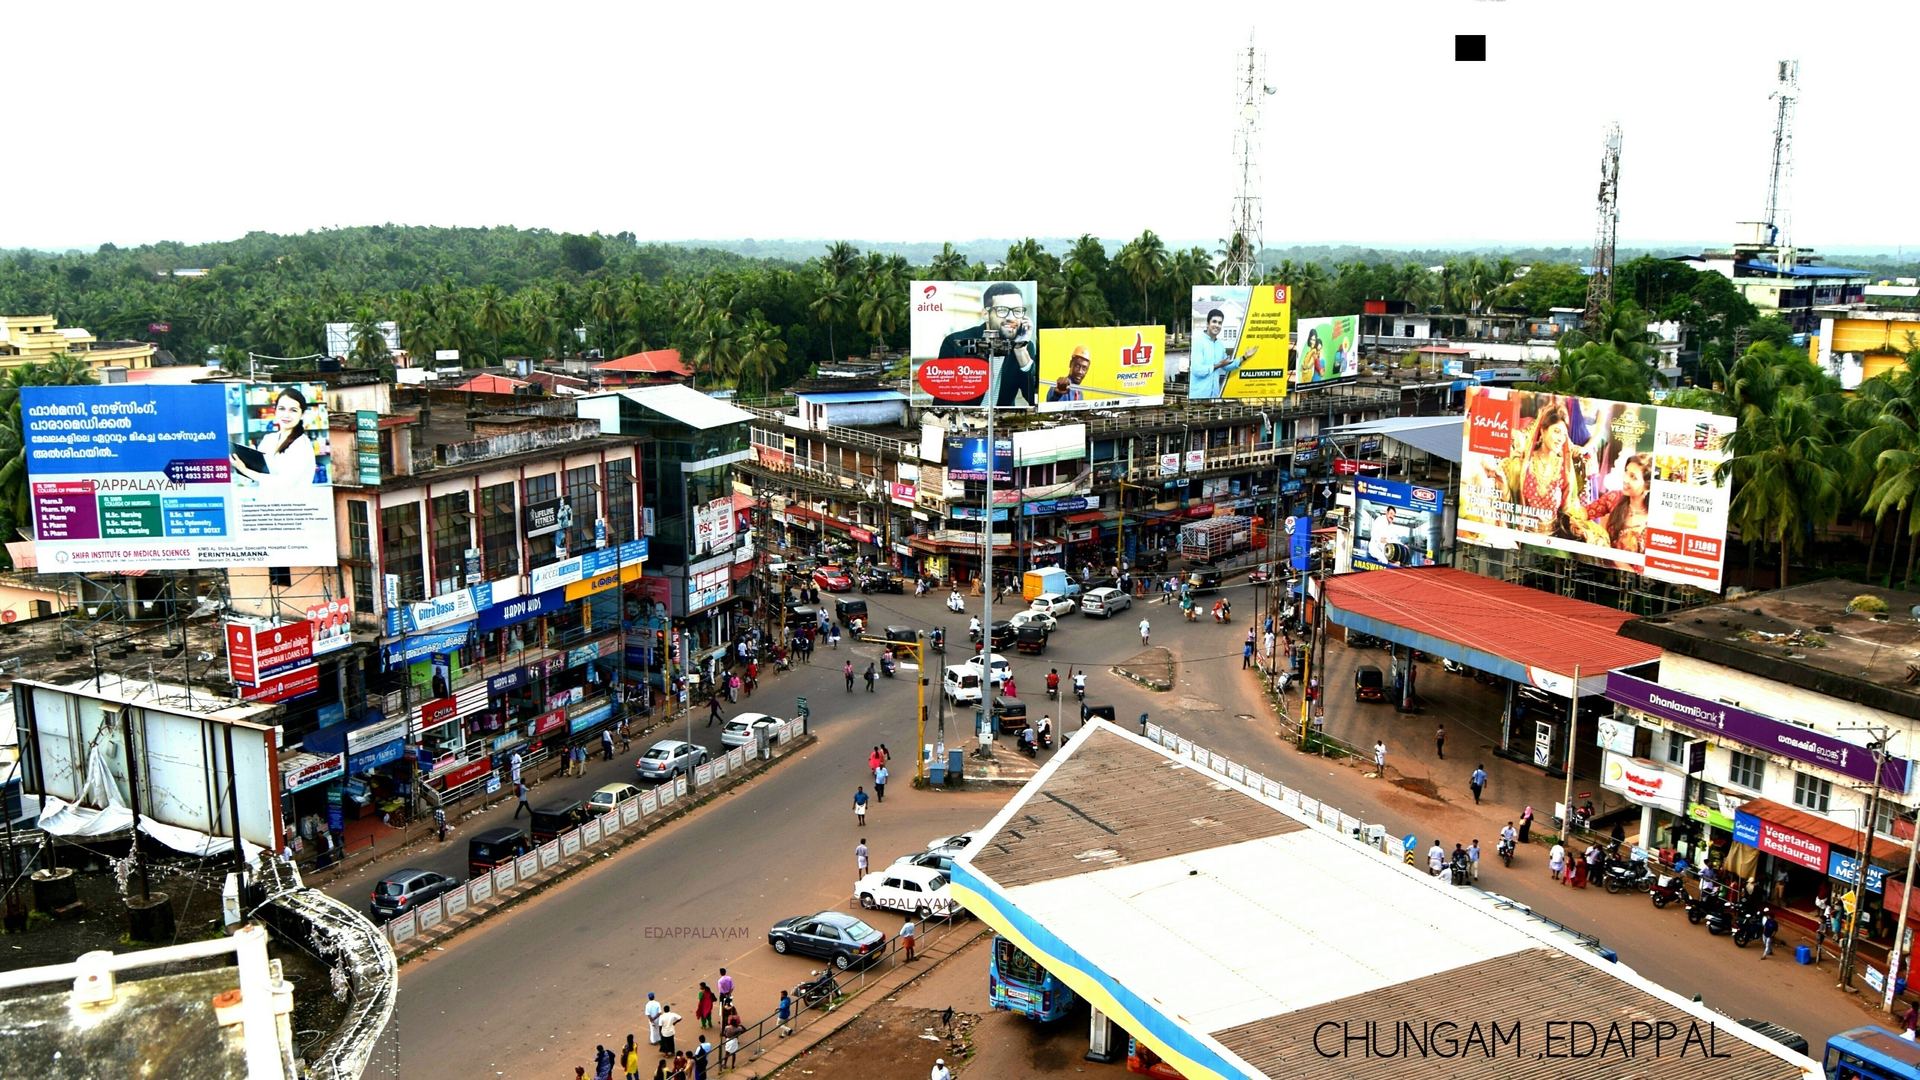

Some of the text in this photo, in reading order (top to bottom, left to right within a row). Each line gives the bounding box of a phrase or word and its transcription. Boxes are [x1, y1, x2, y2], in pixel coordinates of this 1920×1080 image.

[918, 302, 943, 312] airtel
[29, 402, 88, 416] ഫാർമസി,
[30, 417, 132, 430] പാരാമെഡിക്കൽ
[1474, 412, 1508, 430] sanha
[1611, 424, 1634, 434] YEARS
[1662, 492, 1713, 505] READY STITCHING
[534, 507, 554, 518] LIFELINE
[1674, 502, 1704, 512] DESIGNING
[535, 514, 555, 528] FITNESS
[699, 522, 712, 534] PSC
[436, 602, 454, 615] Oasis
[504, 598, 542, 620] HAPPY KIDS
[284, 651, 301, 660] LOANS
[1650, 694, 1718, 722] DhanlaxmiBank
[1778, 735, 1817, 752] ധനലക്ഷ്മി
[1766, 825, 1821, 853] Vegetarian
[1764, 838, 1821, 866] Restaurant
